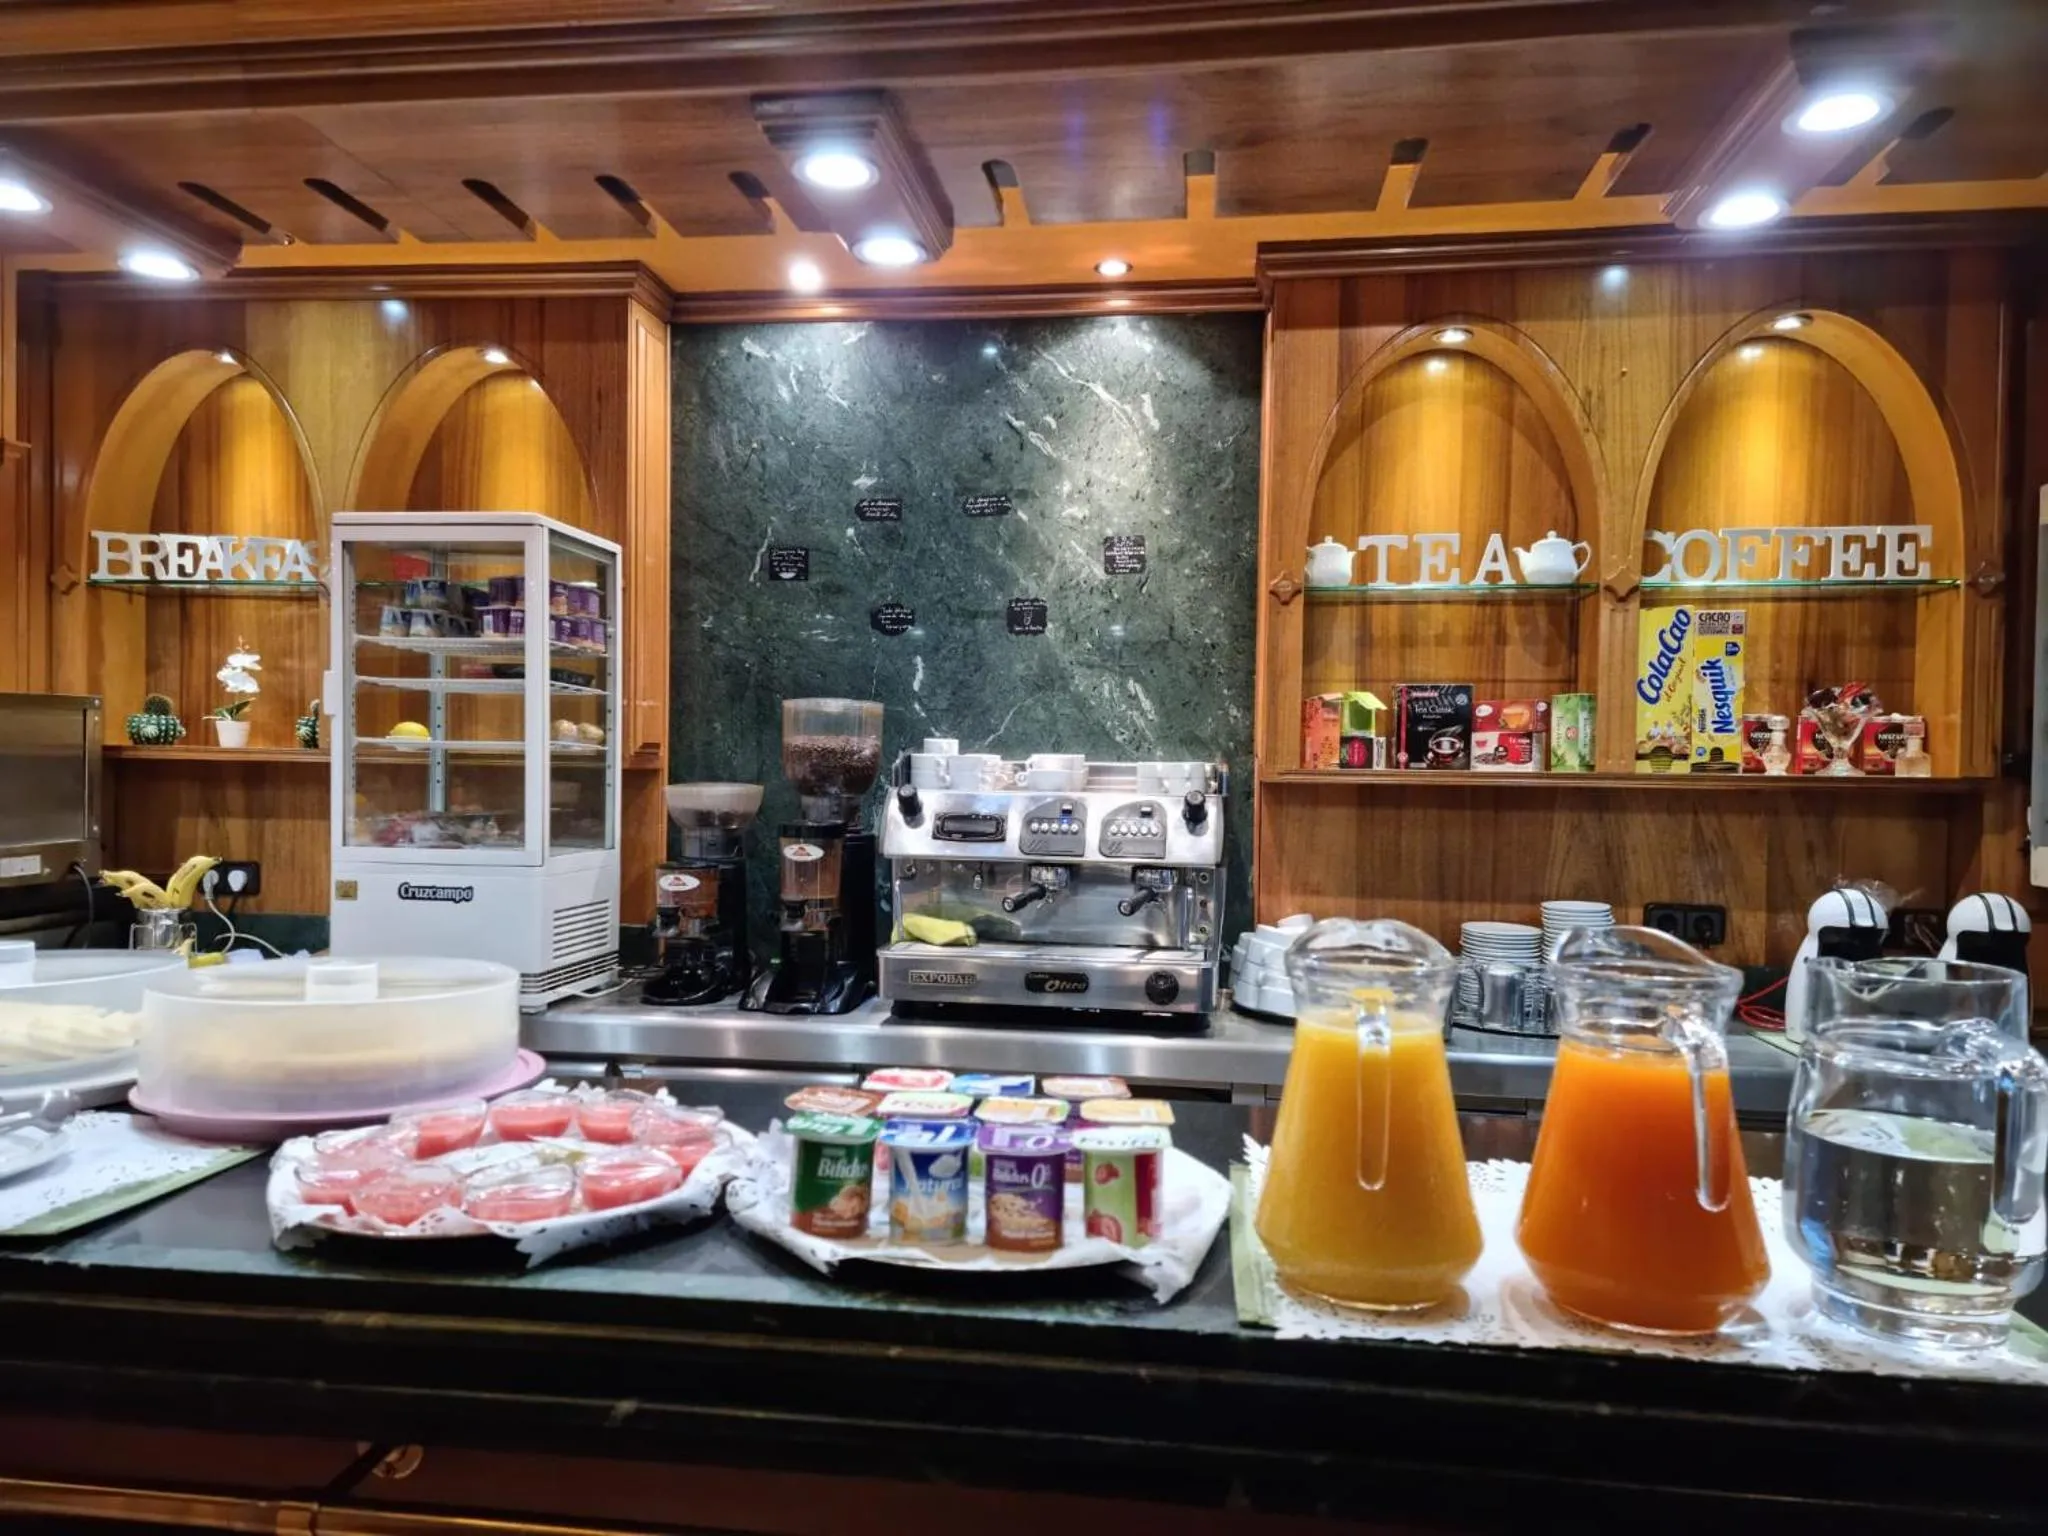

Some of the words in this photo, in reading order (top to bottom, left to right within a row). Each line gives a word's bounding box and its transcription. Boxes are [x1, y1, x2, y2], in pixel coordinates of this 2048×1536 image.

[1358, 532, 1516, 586] TEA
[1641, 524, 1932, 582] COFFEE
[1637, 609, 1691, 704] ColaCao
[1700, 658, 1736, 734] Nesquik
[399, 883, 473, 903] Cruzcampo
[912, 972, 976, 984] EXPOBAR
